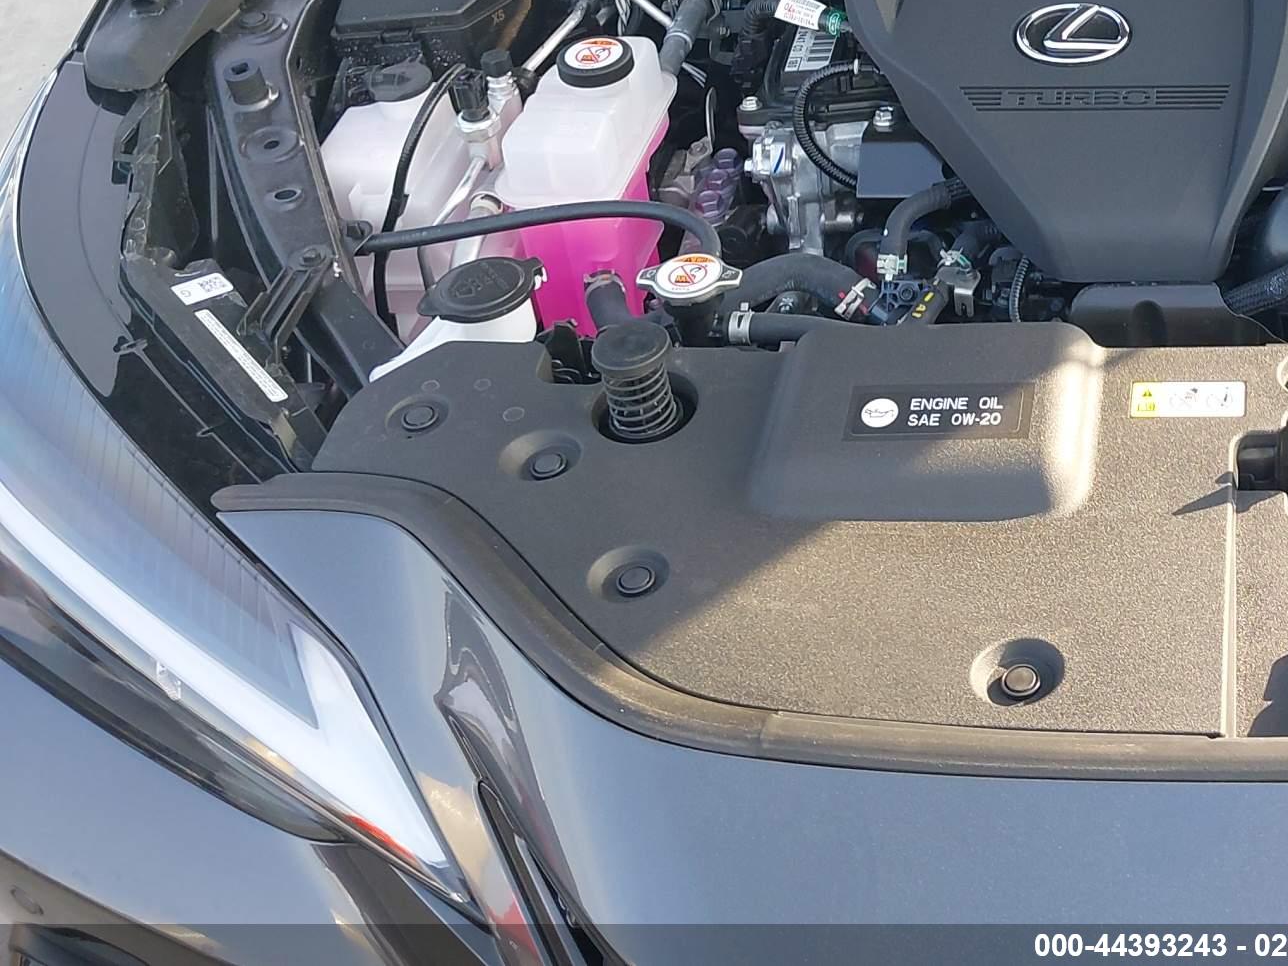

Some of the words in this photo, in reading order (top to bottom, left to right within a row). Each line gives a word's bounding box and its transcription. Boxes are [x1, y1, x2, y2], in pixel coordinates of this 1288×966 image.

[1007, 90, 1151, 107] TURBO
[910, 397, 969, 410] ENGINE
[978, 396, 1004, 409] OIL
[907, 413, 941, 426] SAE
[951, 412, 1002, 426] 0W-20
